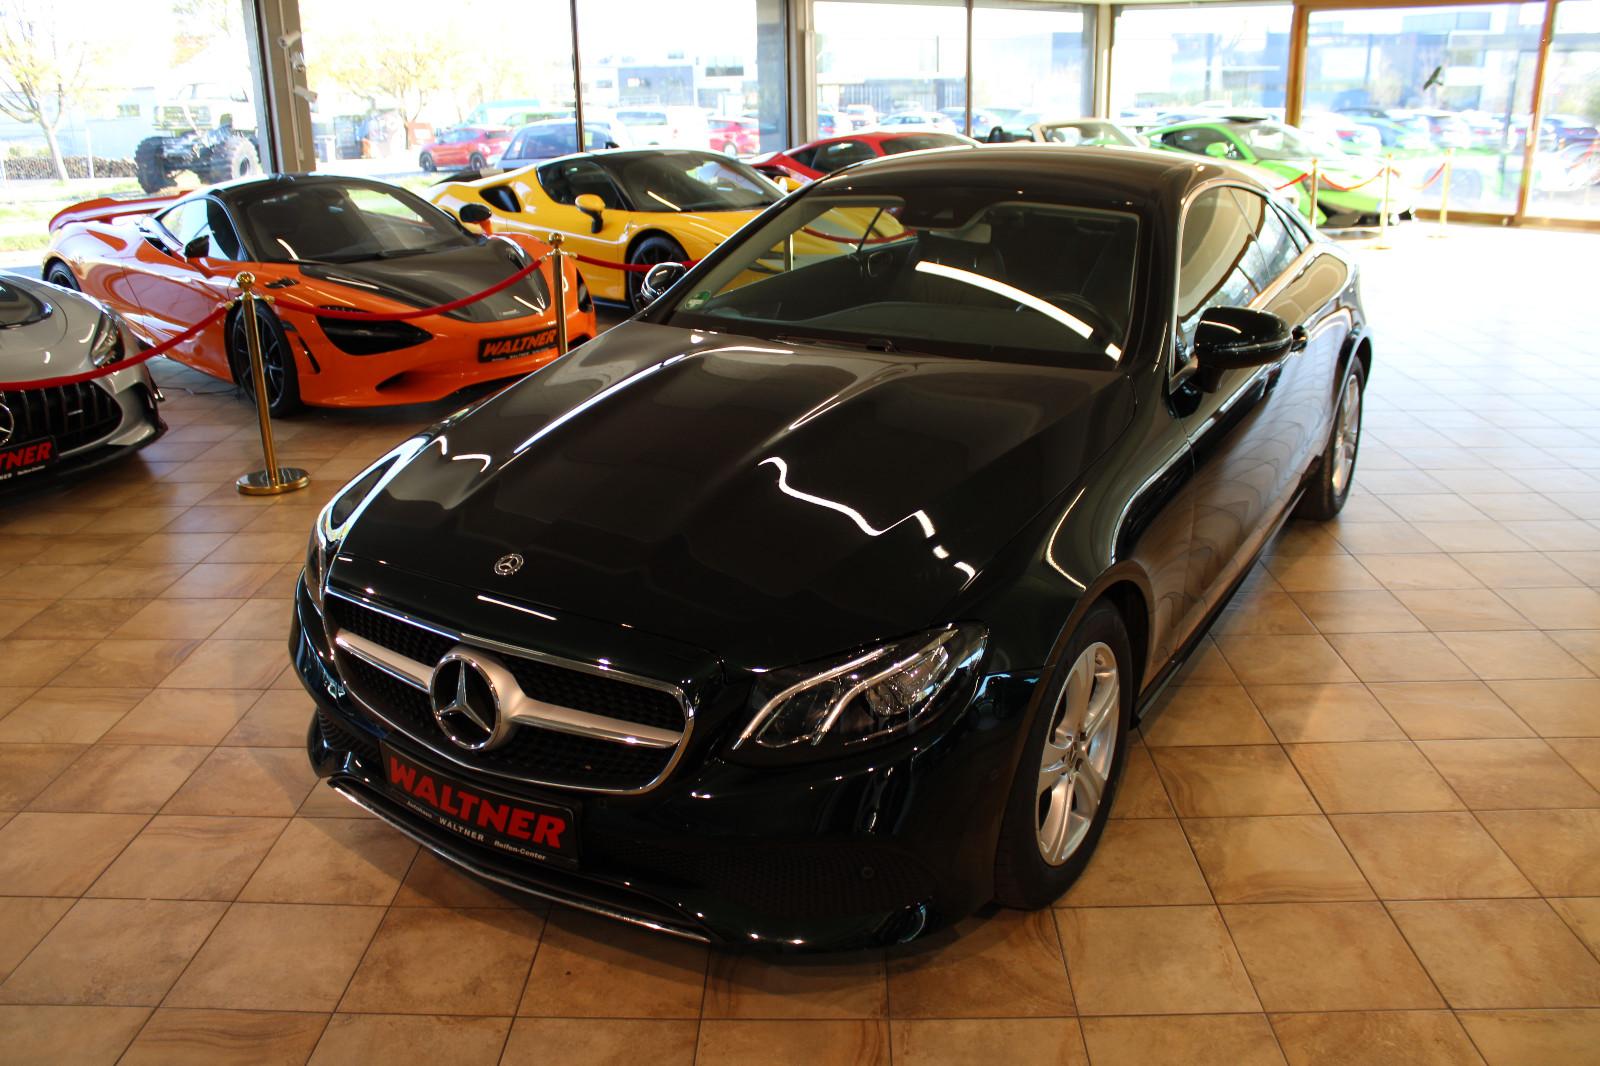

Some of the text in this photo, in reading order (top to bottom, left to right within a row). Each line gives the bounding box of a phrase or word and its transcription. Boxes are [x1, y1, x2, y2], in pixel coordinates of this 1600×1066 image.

[483, 329, 557, 357] WALTNER
[389, 756, 567, 849] WALTNER
[439, 816, 485, 842] WALTNER
[494, 840, 547, 861] Reifen-Center
